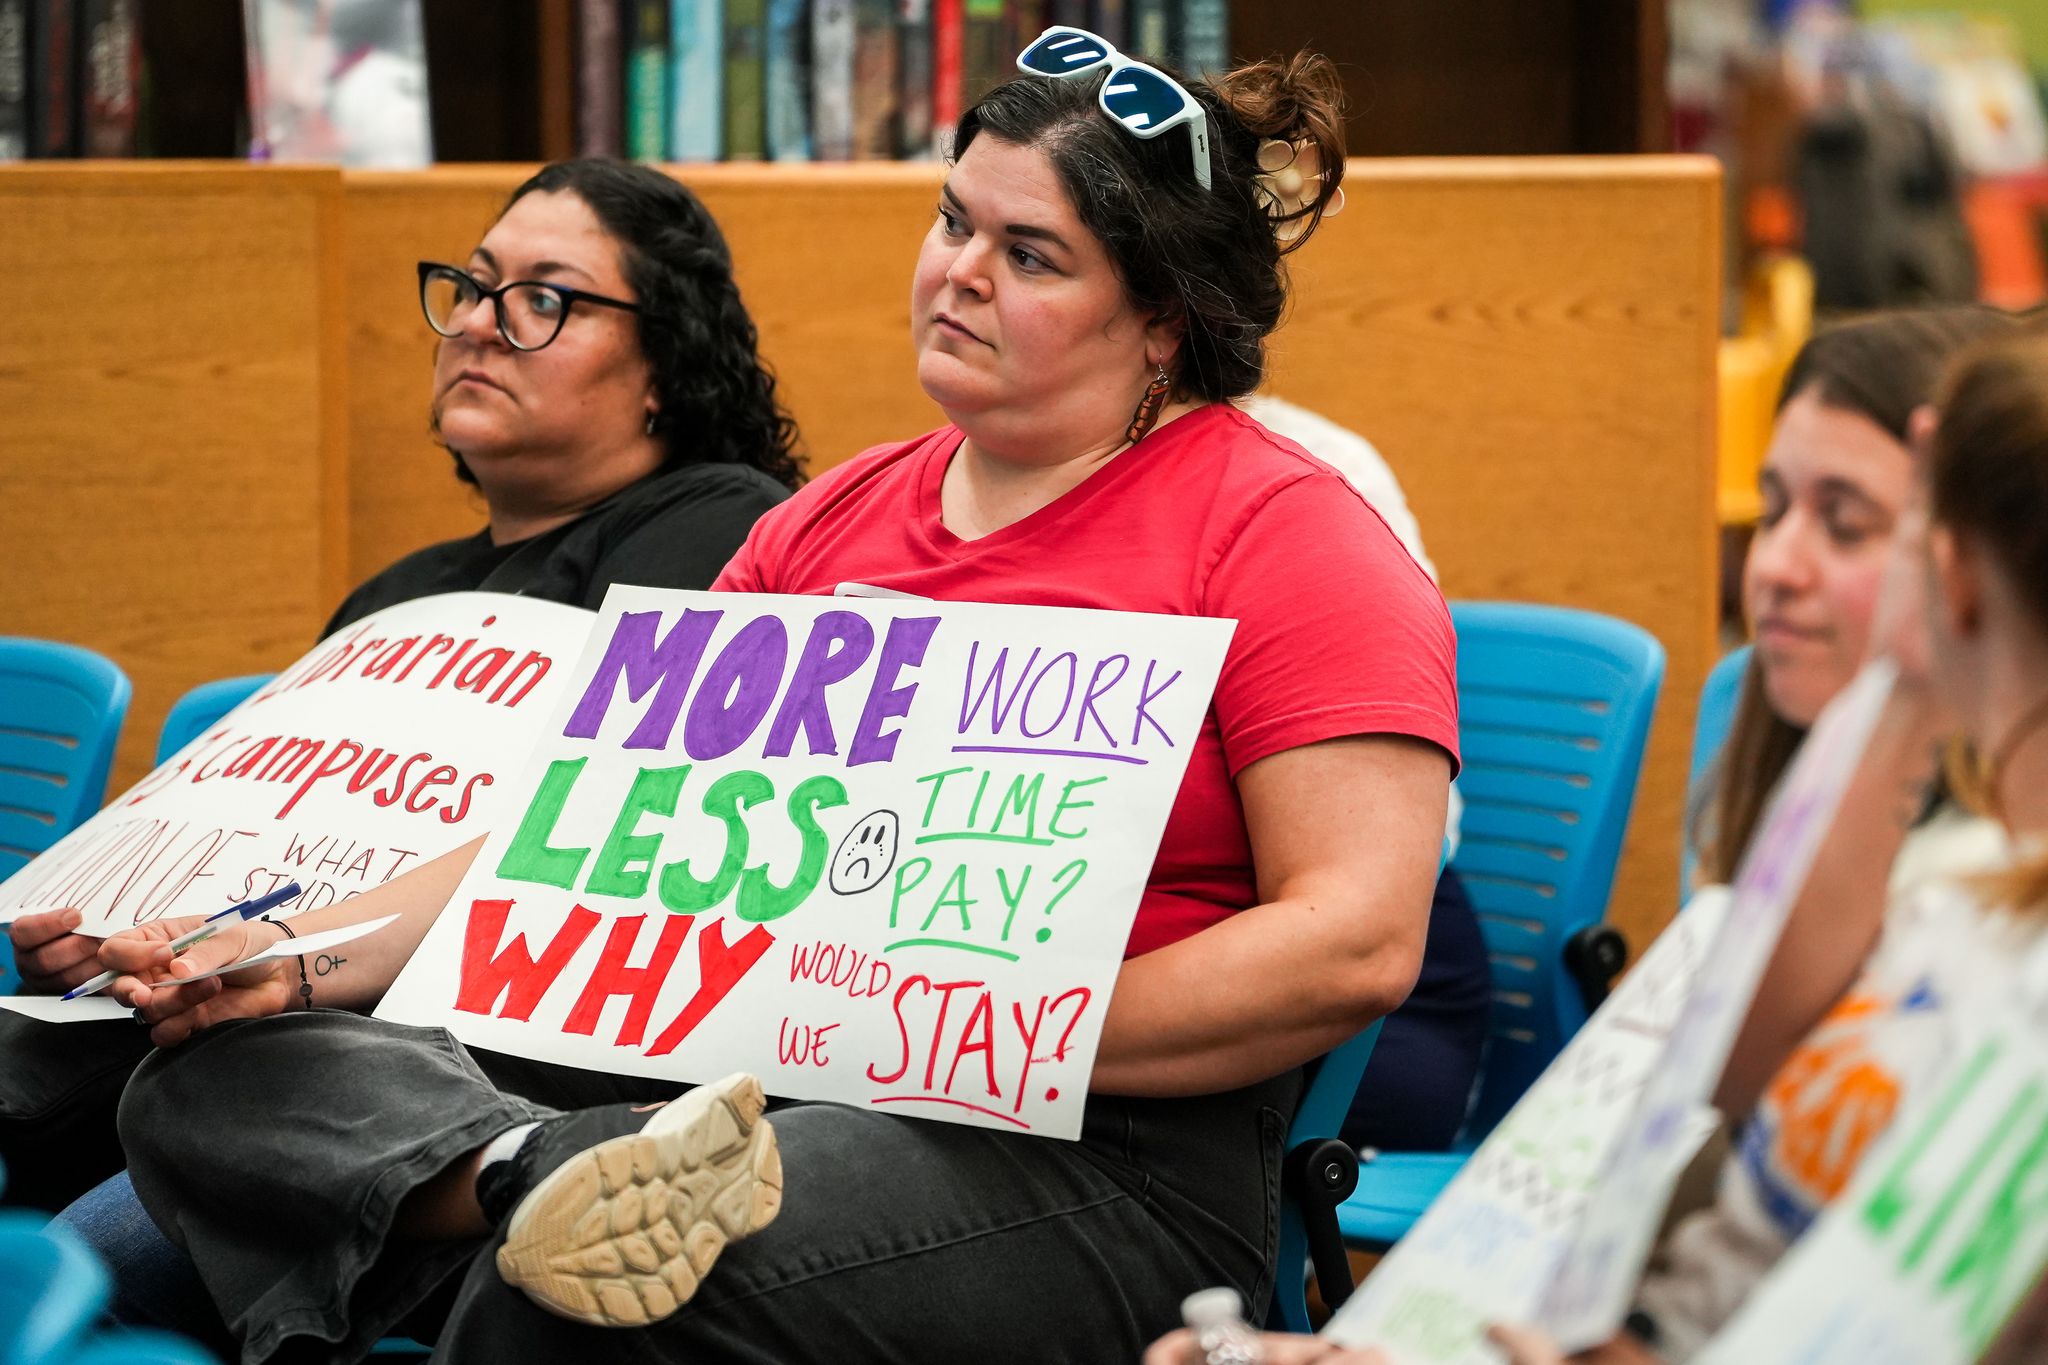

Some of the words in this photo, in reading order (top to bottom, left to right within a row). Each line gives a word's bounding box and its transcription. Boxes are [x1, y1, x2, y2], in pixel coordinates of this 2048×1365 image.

[563, 608, 942, 767] MORE
[958, 640, 1182, 748] WORK
[190, 733, 495, 824] campuses
[915, 766, 1107, 838] TIME
[133, 828, 260, 925] OF
[283, 832, 419, 884] WHAT
[496, 757, 849, 923] LESS
[227, 866, 363, 912] STUD
[888, 856, 1089, 944] PAY?
[453, 898, 777, 1058] WHY
[790, 941, 892, 999] WOULD
[779, 1016, 841, 1068] WE
[866, 975, 1092, 1115] STAY?
